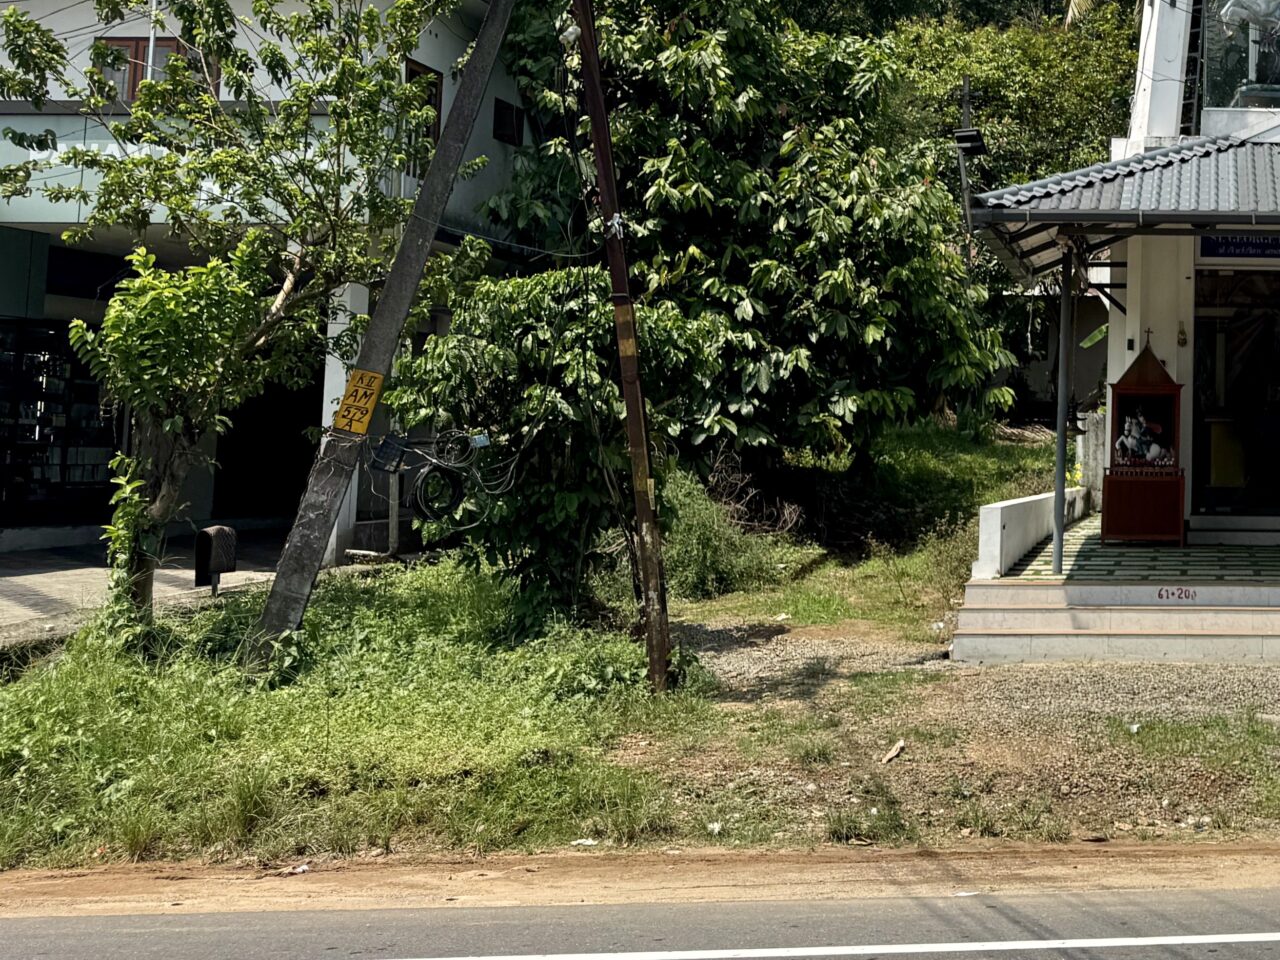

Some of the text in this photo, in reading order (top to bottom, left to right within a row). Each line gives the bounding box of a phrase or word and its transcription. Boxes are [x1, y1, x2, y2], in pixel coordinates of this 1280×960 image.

[346, 389, 375, 406] AM
[342, 407, 369, 420] 579
[342, 419, 353, 431] A
